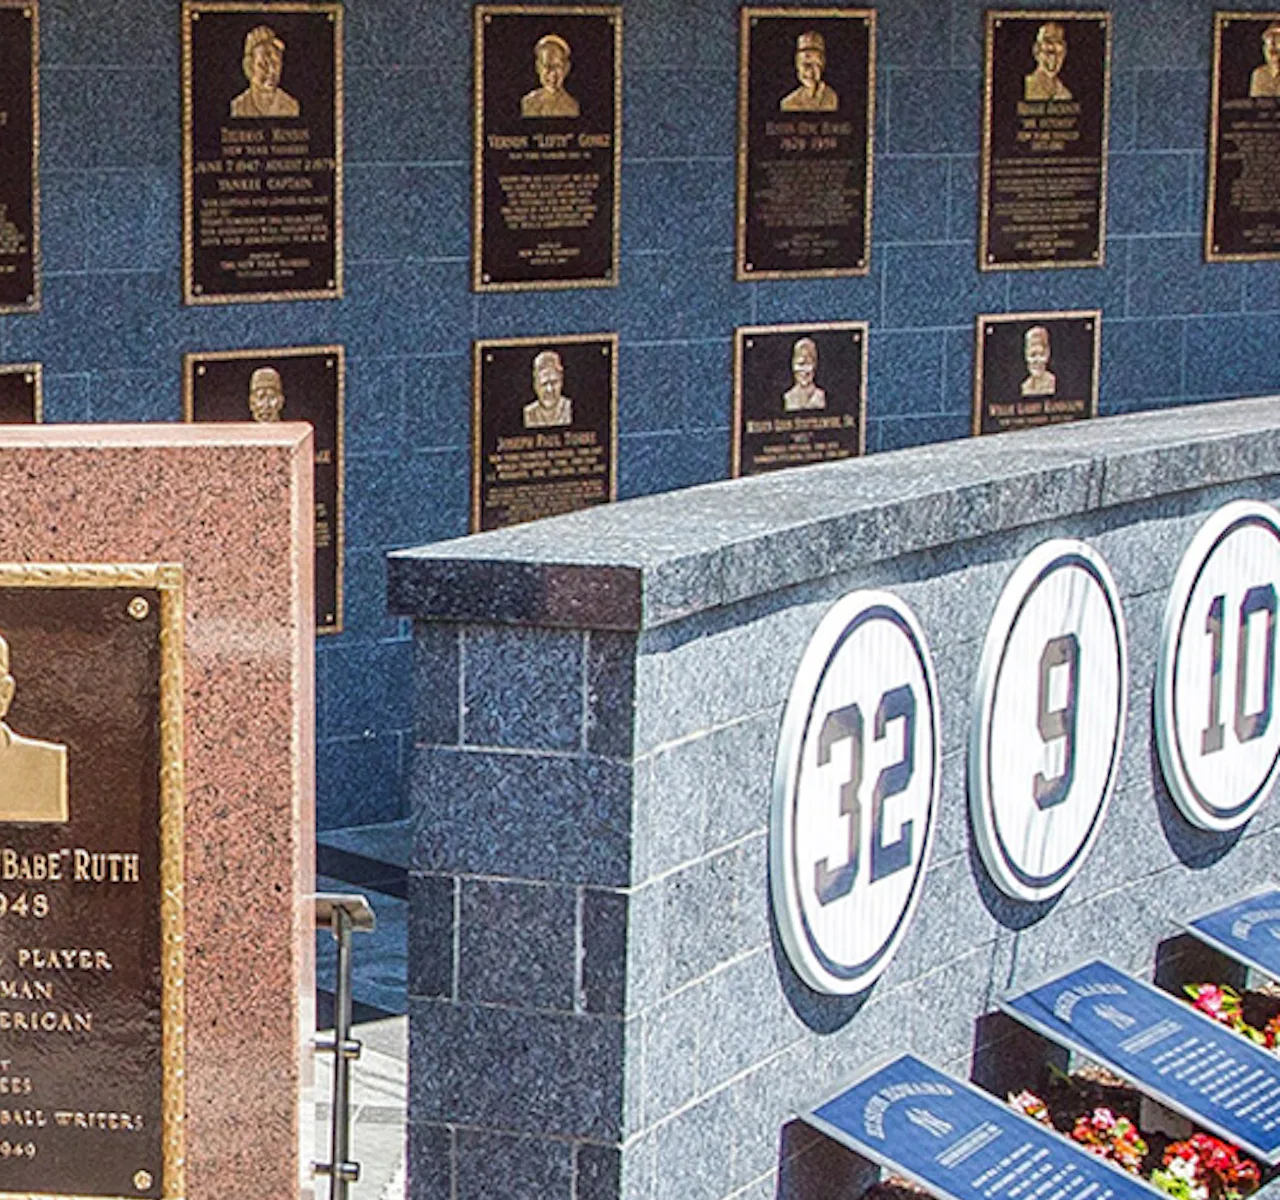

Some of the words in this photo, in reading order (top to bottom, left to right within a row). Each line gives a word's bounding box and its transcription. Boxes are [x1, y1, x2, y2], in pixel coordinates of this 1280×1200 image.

[1201, 583, 1277, 756] 10
[1033, 632, 1080, 811] 9
[814, 684, 917, 907] 32
[73, 848, 140, 883] RUTH
[18, 948, 113, 971] PLAYER
[0, 979, 54, 1000] MAN
[54, 1111, 144, 1132] WRITERS
